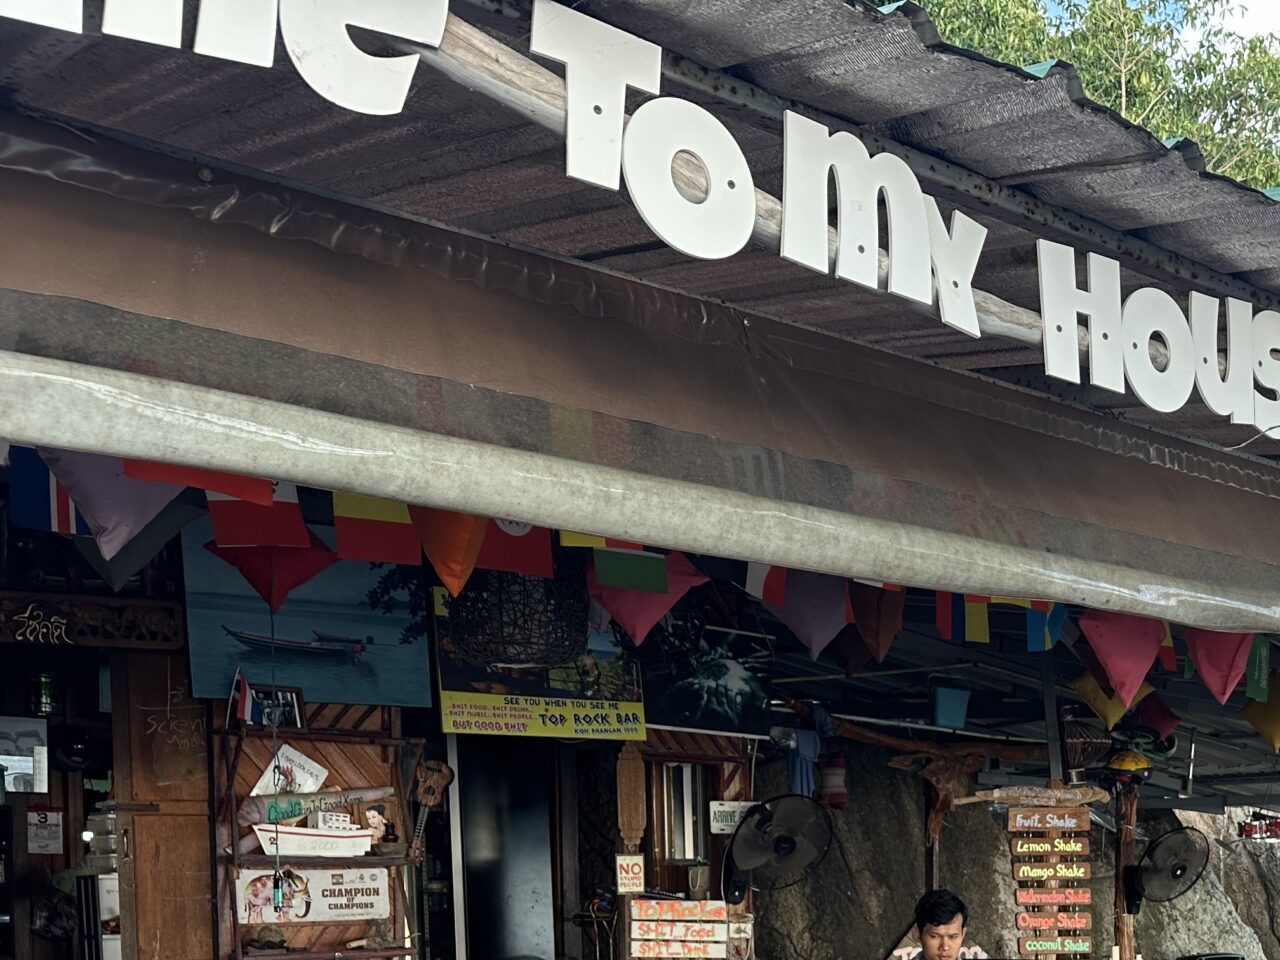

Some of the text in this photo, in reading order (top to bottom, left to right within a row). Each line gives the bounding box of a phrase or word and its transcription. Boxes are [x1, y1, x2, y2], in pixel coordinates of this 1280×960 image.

[530, 0, 756, 260] To
[503, 697, 520, 705] SEE
[524, 698, 540, 706] YOU
[544, 700, 567, 708] WHEN
[571, 701, 587, 709] YOU
[608, 703, 619, 711] ME
[538, 713, 642, 727] TOP ROCK BAR
[713, 811, 738, 824] ARRIVE
[1046, 813, 1077, 828] Shake
[1016, 839, 1083, 852] Lemon Shake
[619, 862, 642, 875] NO
[1019, 864, 1085, 880] Mango Shake
[321, 887, 380, 898] CHAMPION
[328, 902, 375, 910] CHAMPIONS
[1020, 912, 1087, 929] Orange Shake
[1064, 939, 1089, 952] Shake
